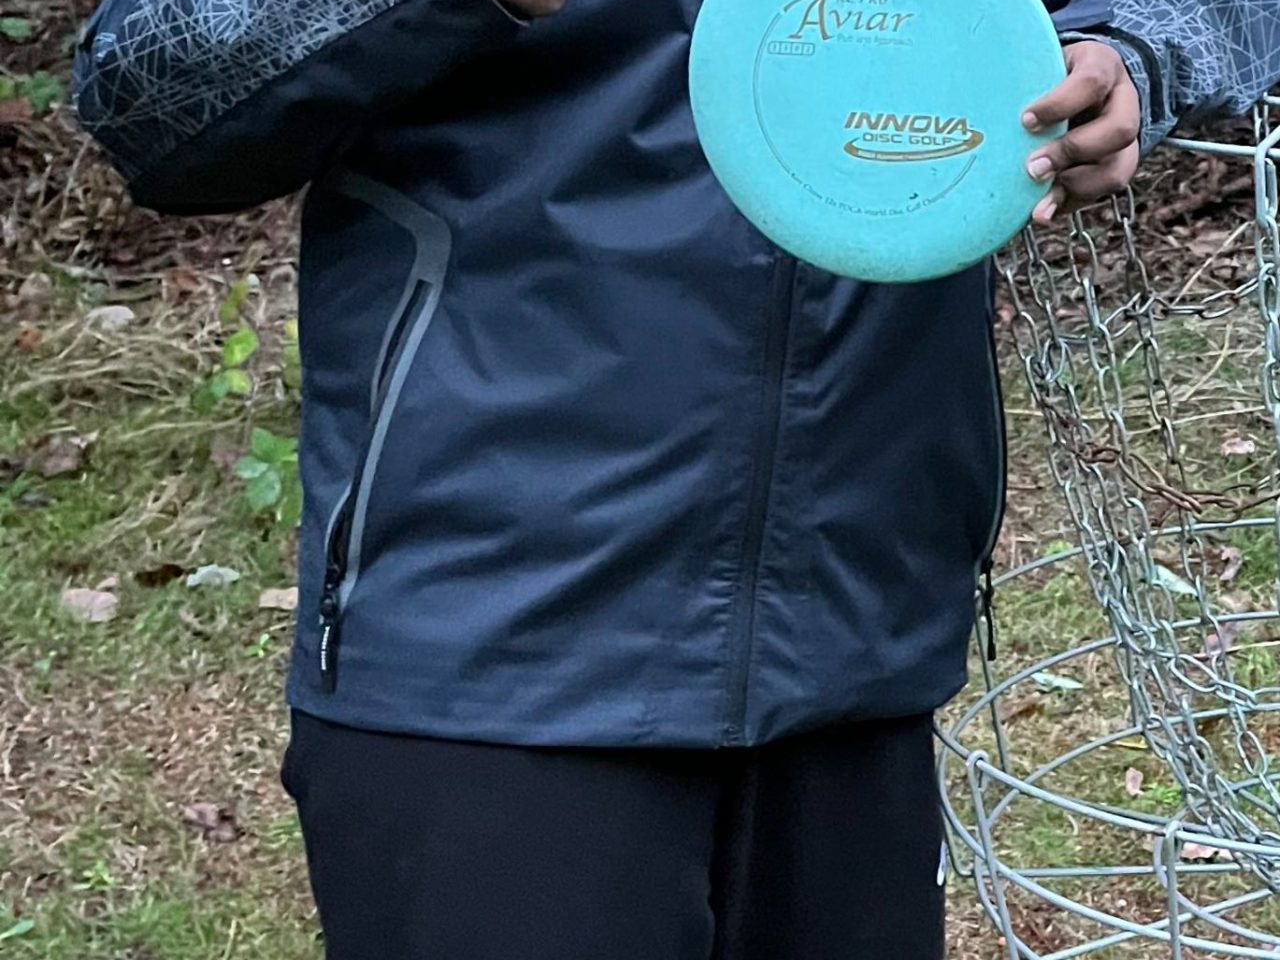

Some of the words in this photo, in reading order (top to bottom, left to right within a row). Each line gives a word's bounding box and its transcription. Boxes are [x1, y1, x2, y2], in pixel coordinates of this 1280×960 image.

[844, 112, 968, 136] INNOVA
[862, 133, 903, 144] DISC
[908, 134, 952, 146] GOLF
